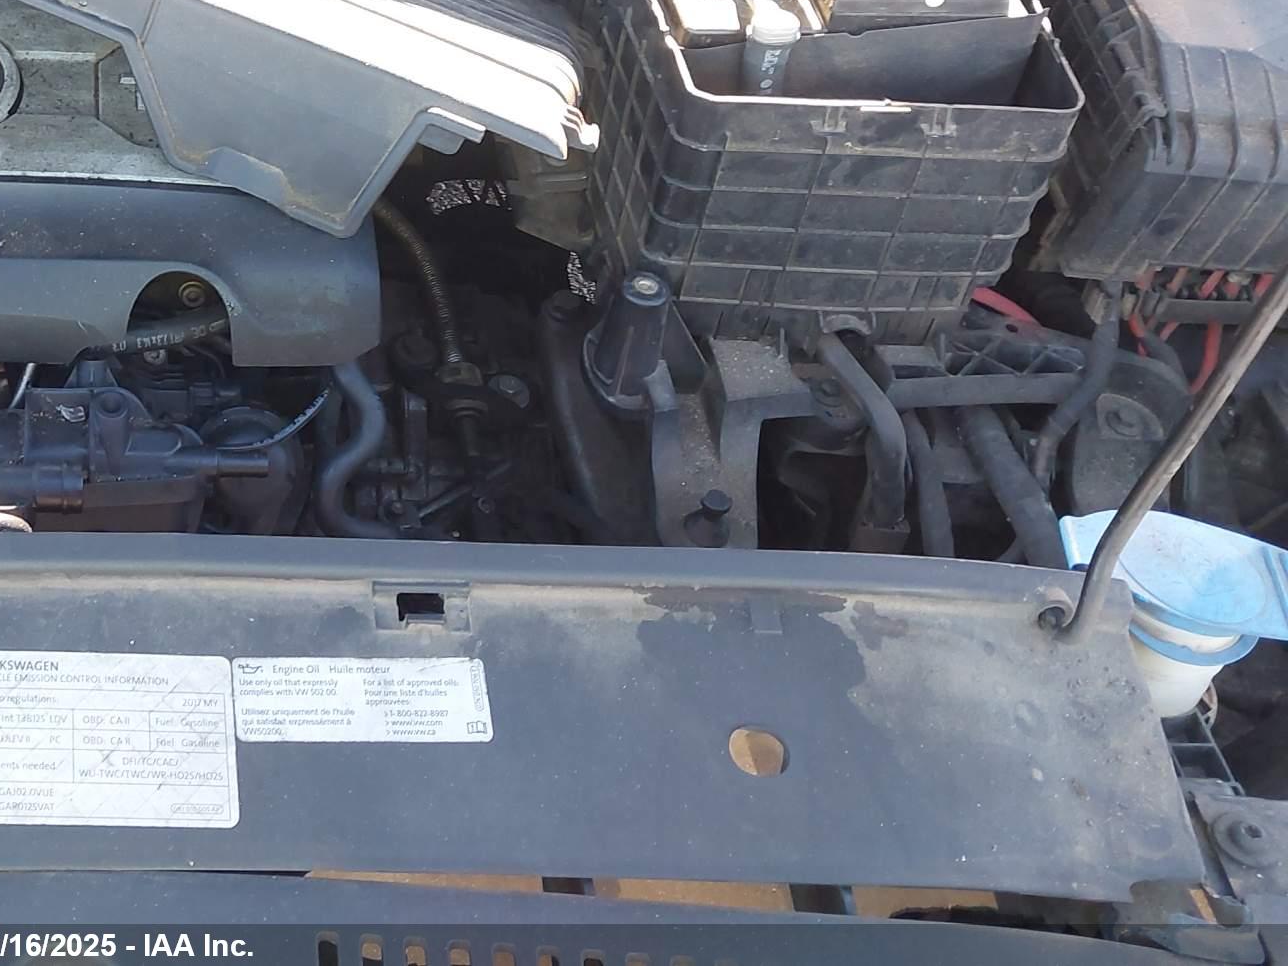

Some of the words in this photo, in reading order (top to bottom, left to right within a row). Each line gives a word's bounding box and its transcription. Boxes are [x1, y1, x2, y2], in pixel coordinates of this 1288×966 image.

[273, 665, 305, 676] Engine
[306, 665, 320, 674] Oil
[329, 665, 353, 674] Huile
[356, 666, 390, 674] moteur
[14, 674, 57, 683] EMISSION
[60, 675, 101, 684] CONTROL
[104, 676, 169, 685] INFORMATION
[363, 679, 375, 687] For
[377, 679, 382, 687] a
[384, 679, 395, 687] list
[397, 679, 405, 687] of
[407, 679, 442, 687] approved
